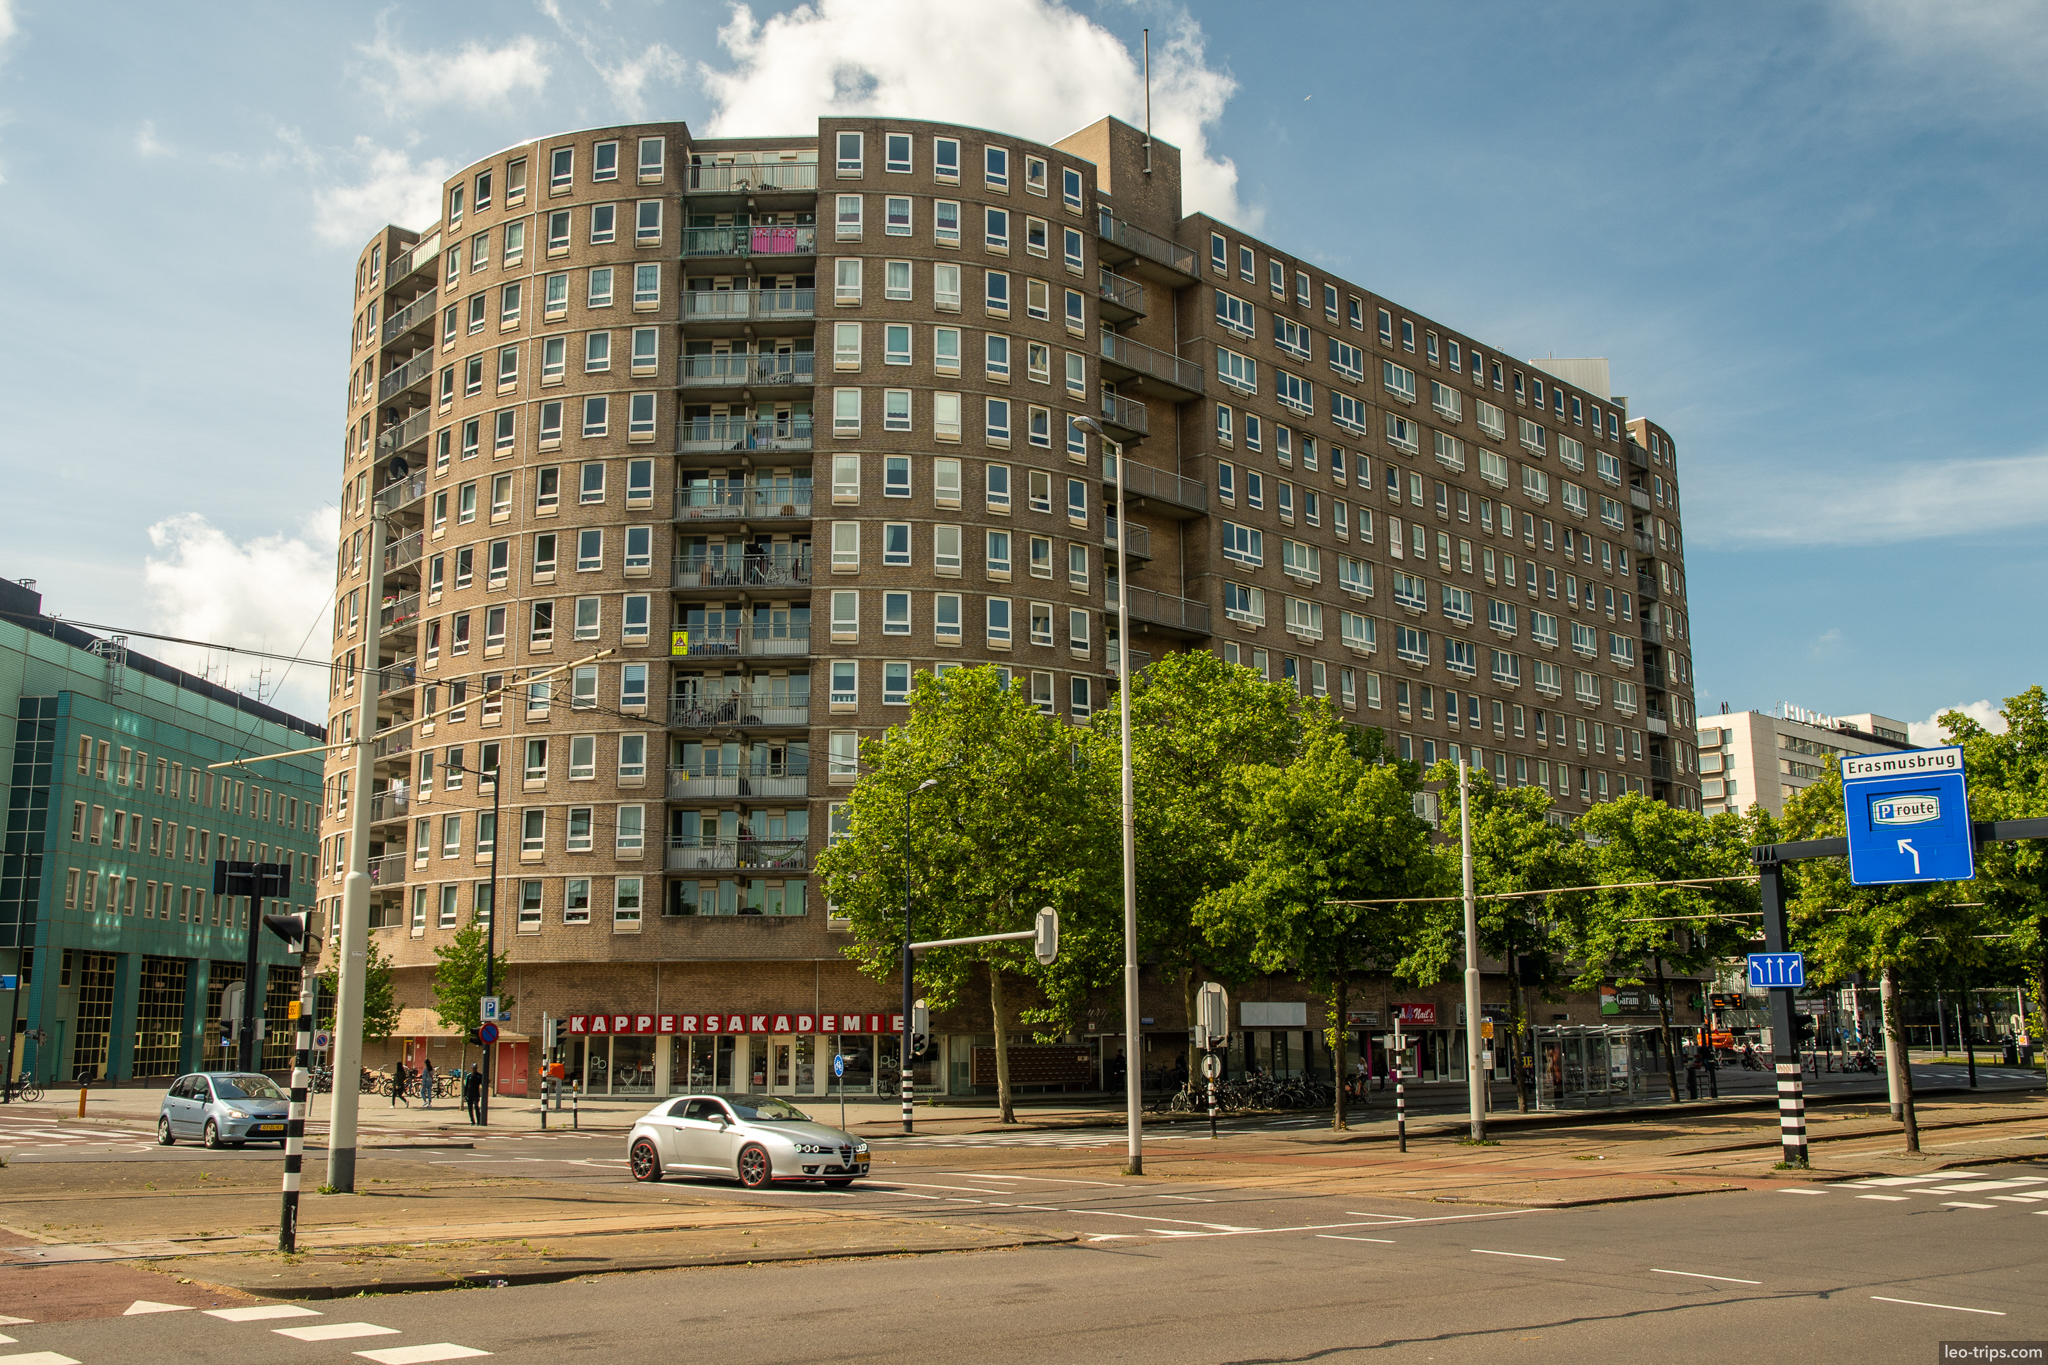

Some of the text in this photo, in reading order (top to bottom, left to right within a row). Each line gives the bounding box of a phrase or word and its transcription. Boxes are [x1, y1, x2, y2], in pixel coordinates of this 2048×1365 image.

[1784, 701, 1840, 729] HILTON
[1848, 754, 1955, 774] Erasmusbrug
[1896, 802, 1934, 816] route
[1616, 993, 1639, 1006] Garam
[1406, 1004, 1414, 1022] 4
[571, 1015, 904, 1032] KAPPERSAKADEMIE
